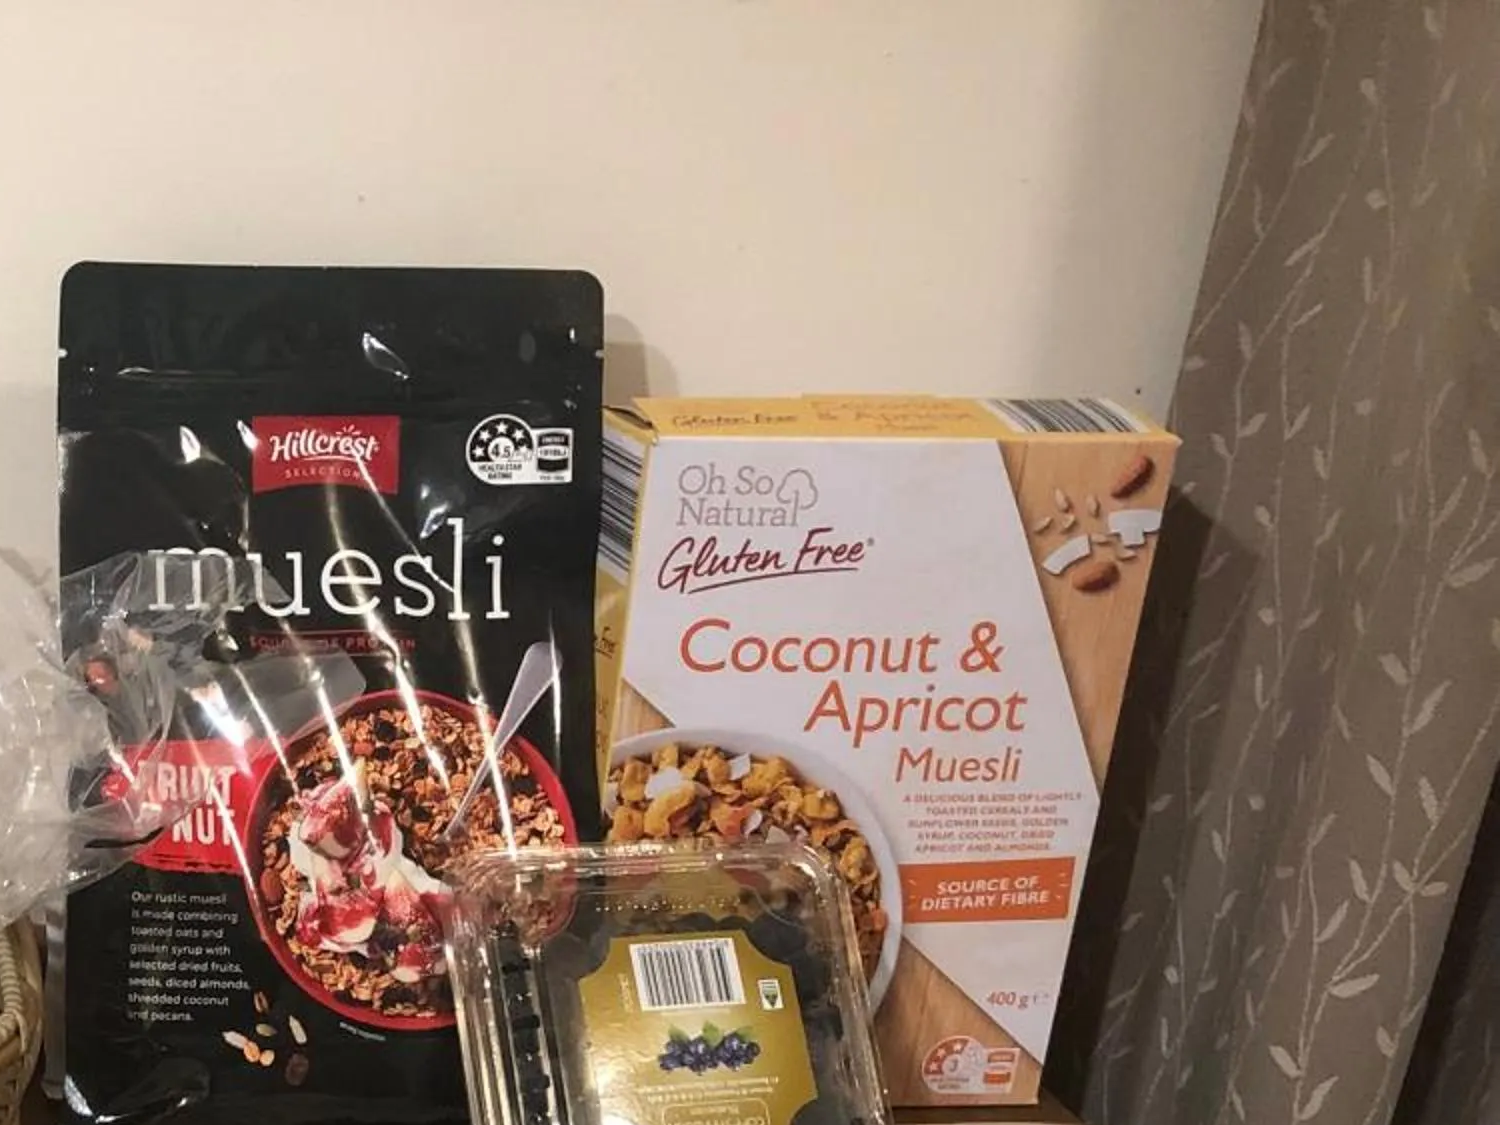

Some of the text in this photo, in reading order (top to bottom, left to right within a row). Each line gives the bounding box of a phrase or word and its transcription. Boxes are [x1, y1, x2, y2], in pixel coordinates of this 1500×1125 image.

[268, 428, 377, 462] Hillcrest
[677, 464, 774, 497] Oh So
[676, 498, 800, 528] Natural
[147, 517, 511, 619] muesli
[657, 526, 867, 592] Gluten Free
[679, 618, 940, 675] Coconut
[959, 621, 1006, 674] &
[802, 679, 1028, 748] Apricot
[895, 746, 1023, 783] Muesli
[171, 805, 236, 846] NUT
[936, 875, 1041, 896] SOURCE OF
[131, 891, 228, 905] Our rustic muesli
[920, 890, 1051, 912] DIETARY FIBRE
[142, 908, 175, 920] made
[177, 911, 239, 925] combining
[131, 926, 225, 939] toasted oats and
[171, 946, 203, 957] syrup
[205, 946, 231, 956] with
[129, 960, 177, 971] selected
[178, 962, 209, 973] dried
[165, 979, 198, 989] diced
[127, 992, 229, 1006] shredded coconut
[986, 991, 1017, 1006] 400
